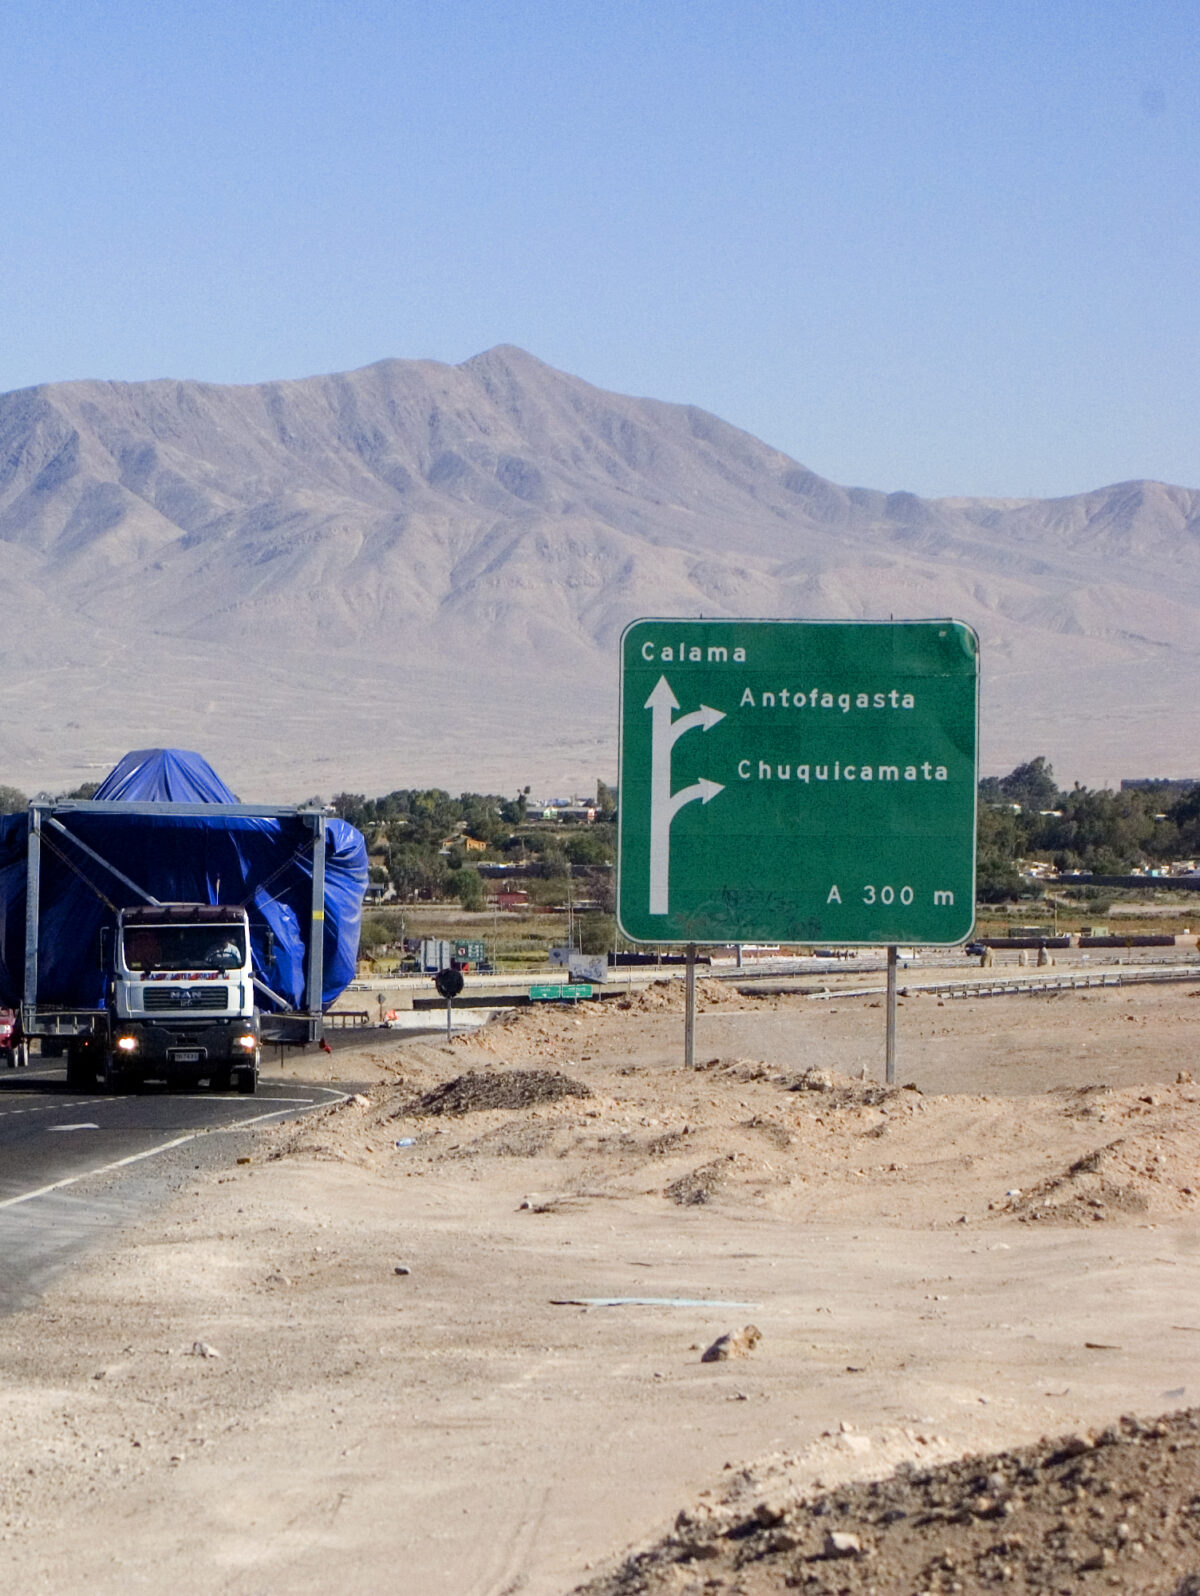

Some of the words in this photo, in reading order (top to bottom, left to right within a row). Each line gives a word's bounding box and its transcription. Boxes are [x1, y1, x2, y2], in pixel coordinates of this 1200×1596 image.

[640, 641, 746, 662] Calama
[739, 687, 915, 713] Antofagasta
[737, 759, 948, 783] Chuquicamata
[826, 885, 842, 905] A
[863, 885, 913, 905] 300
[934, 890, 954, 905] m
[169, 991, 202, 999] MAN
